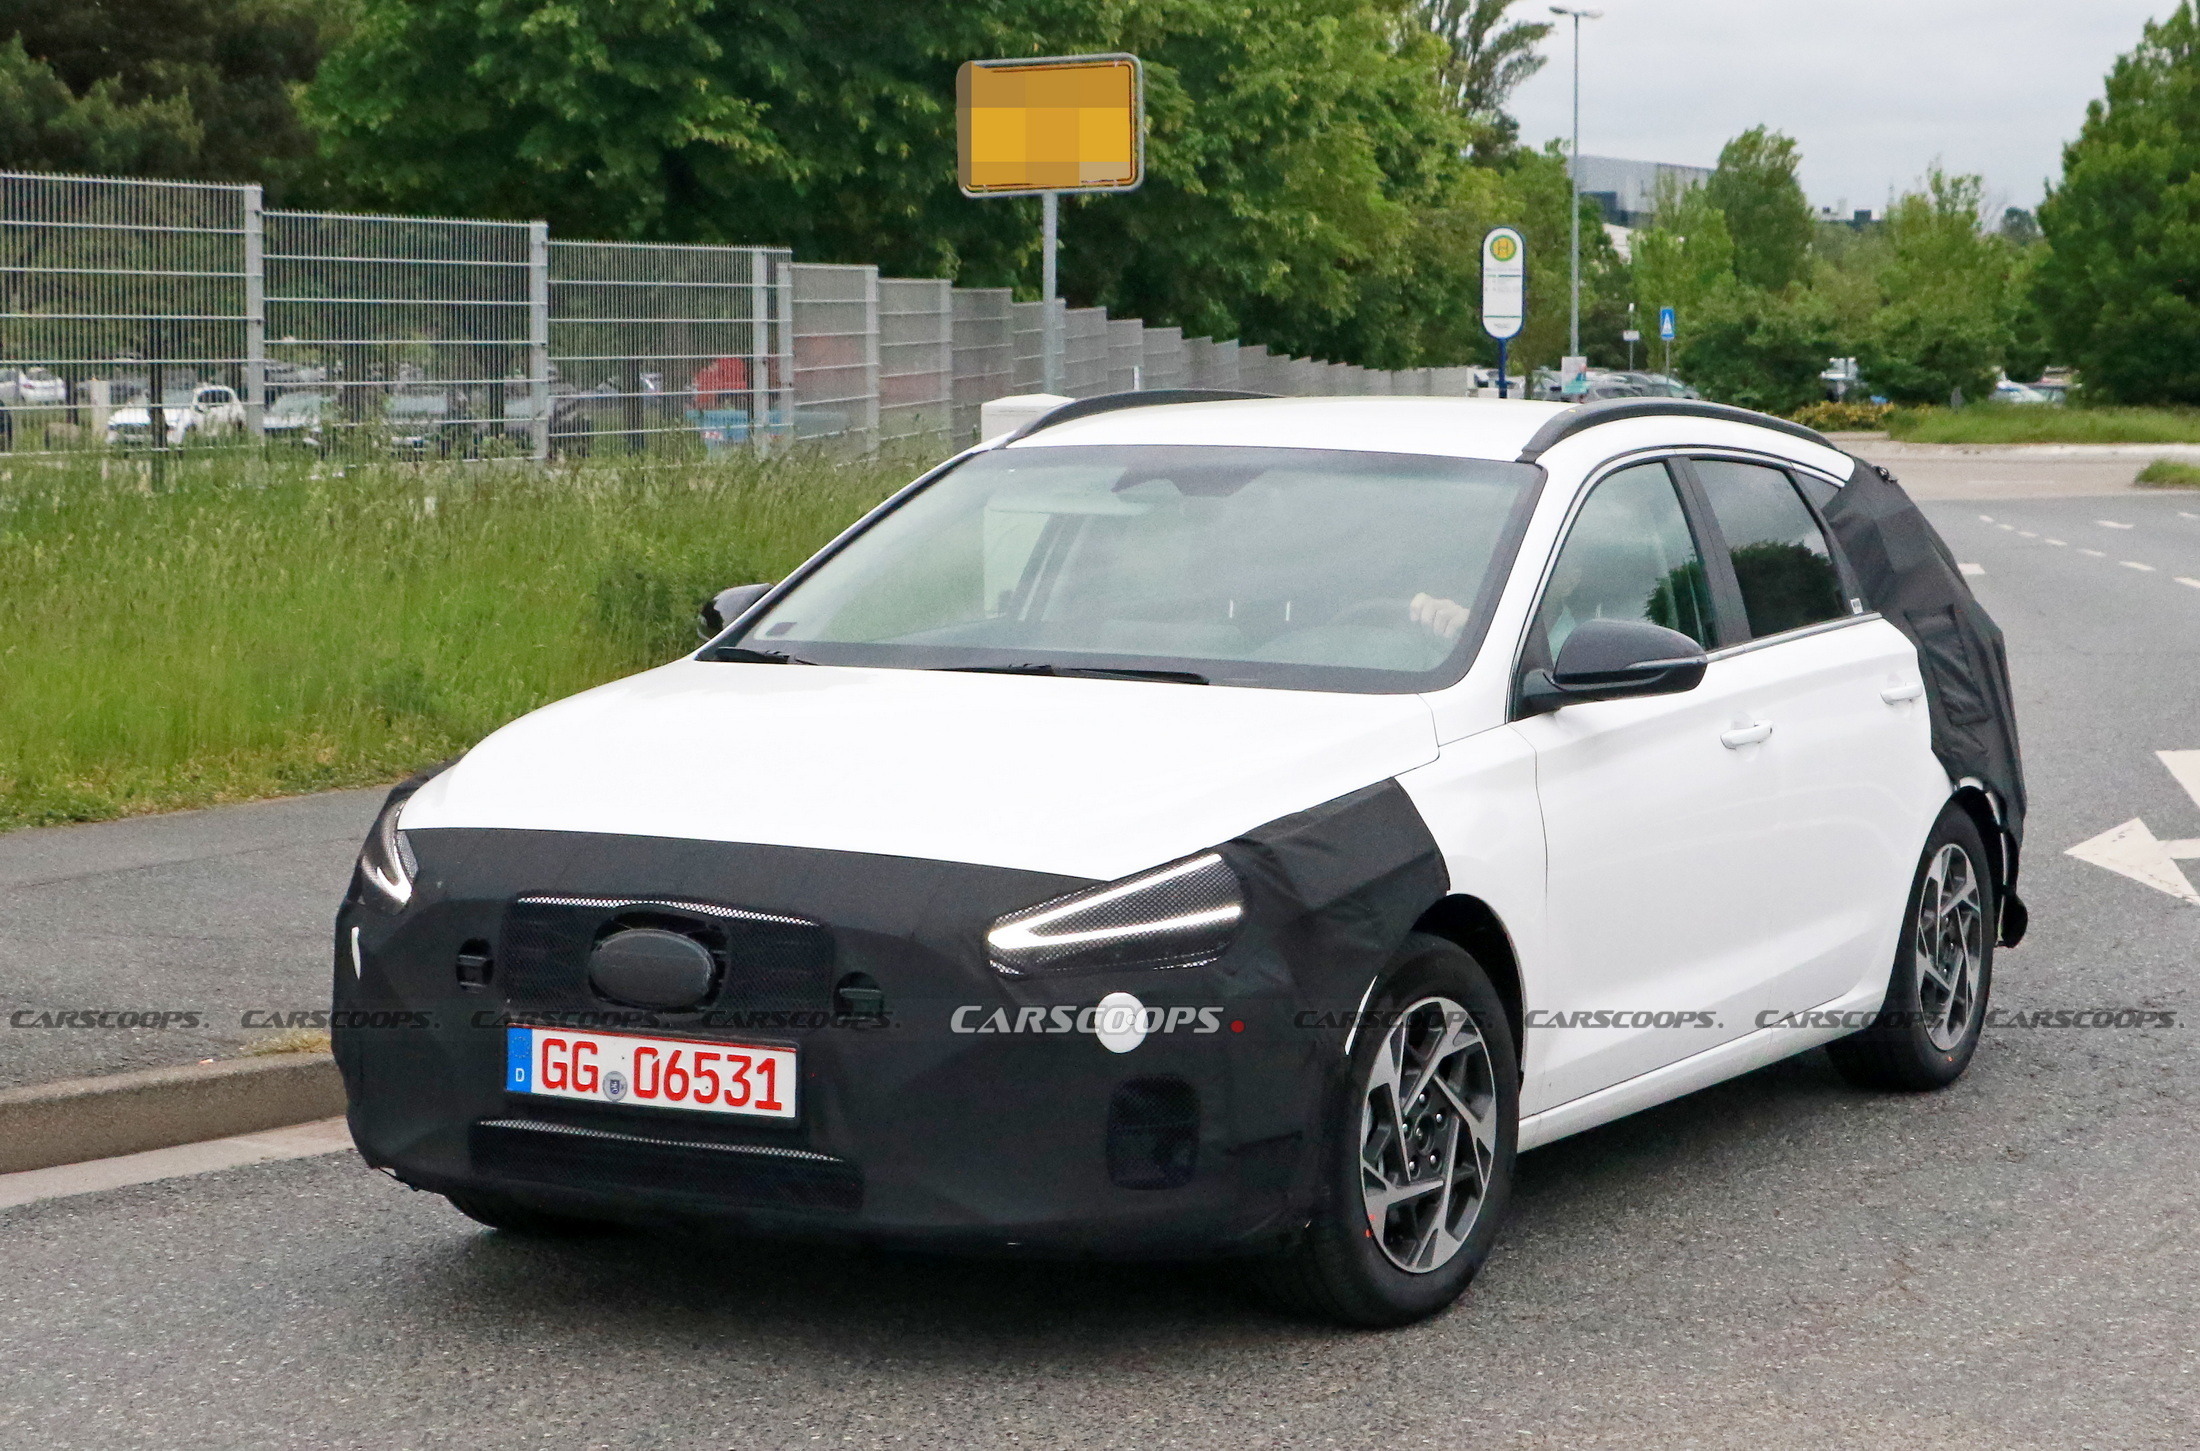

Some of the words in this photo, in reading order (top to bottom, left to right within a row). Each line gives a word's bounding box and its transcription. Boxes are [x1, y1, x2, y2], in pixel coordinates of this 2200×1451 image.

[1497, 240, 1508, 256] H
[515, 1068, 525, 1082] D
[541, 1038, 598, 1093] GG
[633, 1046, 782, 1111] 06531
